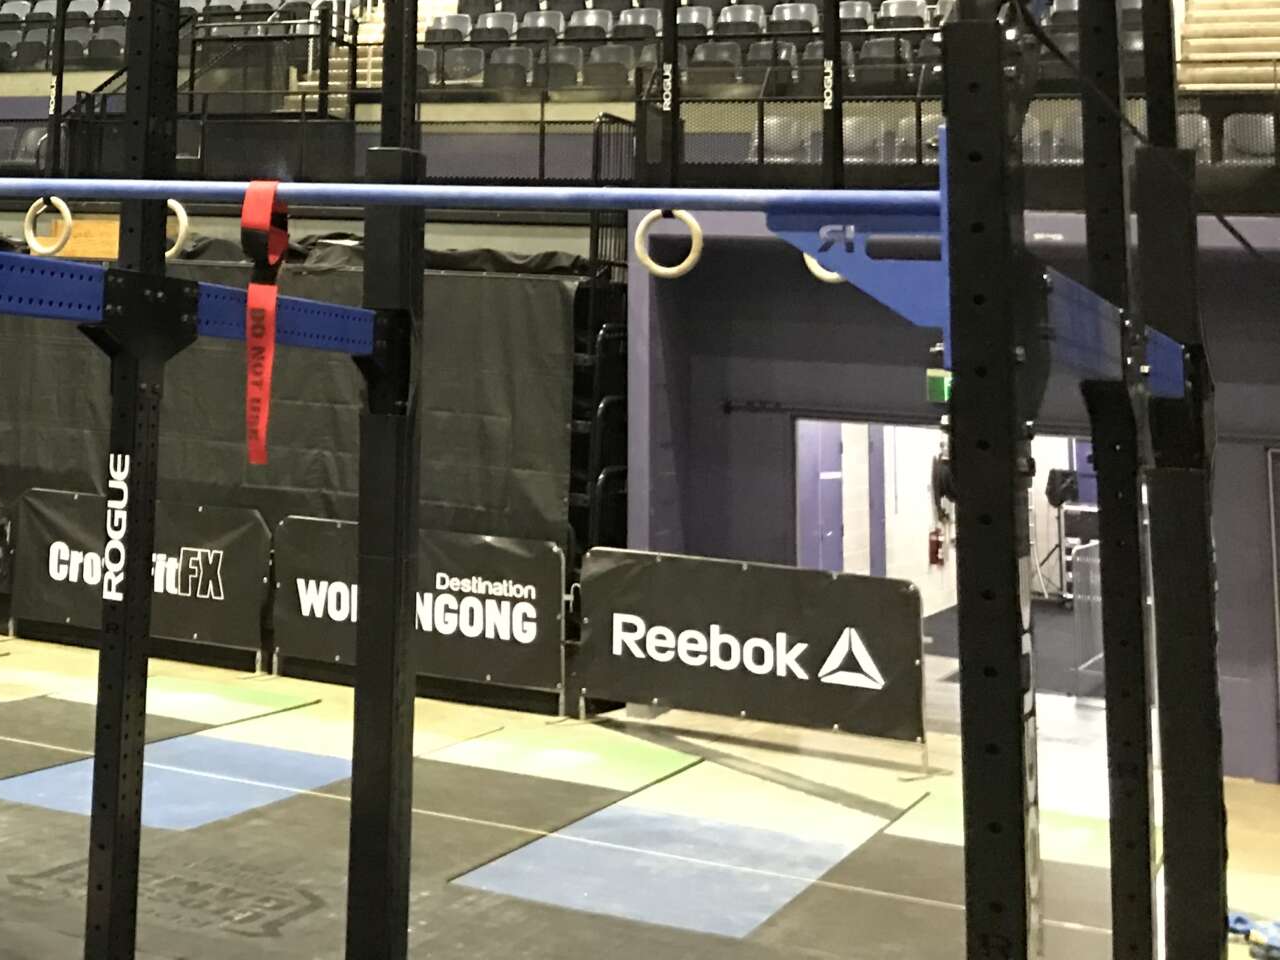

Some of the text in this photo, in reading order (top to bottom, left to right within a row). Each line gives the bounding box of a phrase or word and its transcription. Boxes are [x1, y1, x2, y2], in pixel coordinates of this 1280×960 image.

[663, 63, 672, 111] ROGUE
[823, 59, 833, 110] ROGUE
[250, 307, 267, 339] DO
[250, 345, 267, 391] NOT
[102, 453, 131, 602] ROGUE
[435, 572, 537, 600] Destination
[611, 612, 809, 681] Reebok
